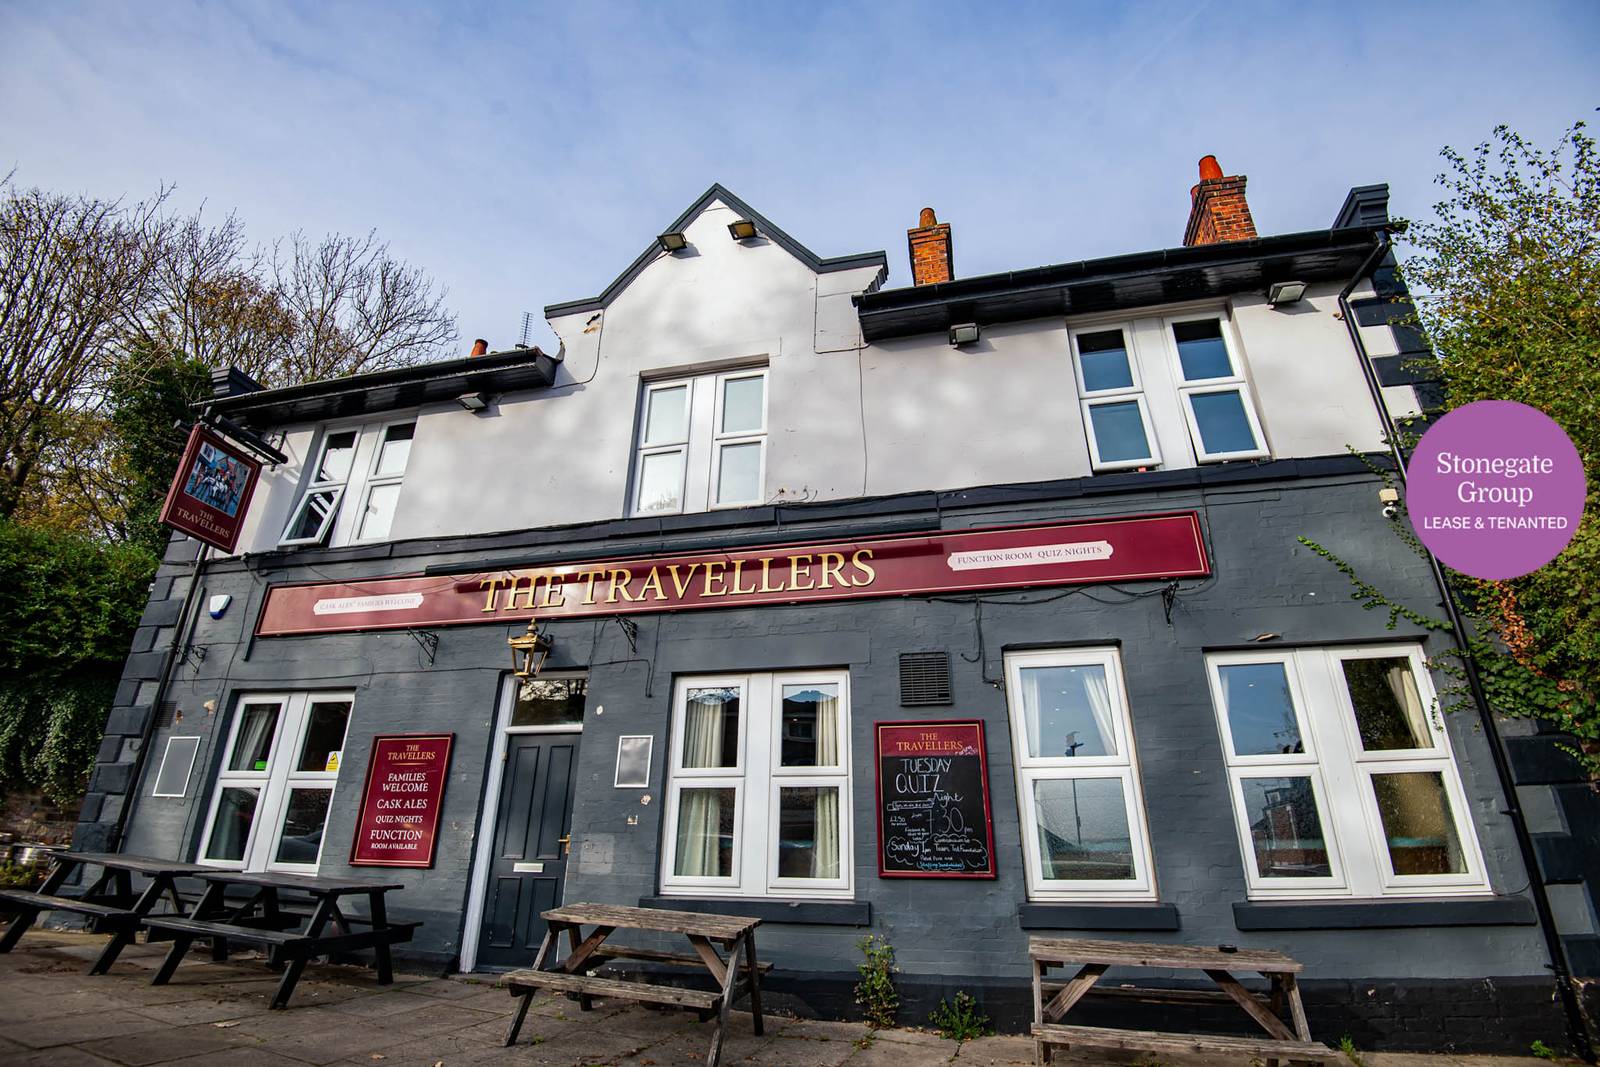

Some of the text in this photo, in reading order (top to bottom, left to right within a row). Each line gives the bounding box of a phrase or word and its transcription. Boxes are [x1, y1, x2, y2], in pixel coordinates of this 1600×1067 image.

[199, 510, 215, 520] THE
[177, 507, 230, 538] TRAVELLERS
[957, 547, 1103, 564] FUNCTION ROOM QUIZ NIGHTS
[479, 549, 876, 613] THE TRAVELLERS
[896, 741, 963, 751] TRAVELLERS
[387, 752, 436, 760] TRAVELLERS
[900, 758, 952, 773] TUESDAY
[388, 773, 426, 782] FAMILIES
[382, 783, 429, 792] WELCOME
[896, 773, 944, 793] QUIZ
[376, 799, 427, 809] CASK ALES
[375, 816, 423, 824] QUIZ NIGHTS
[370, 830, 423, 840] FUNCTION
[891, 841, 920, 858] Sunday
